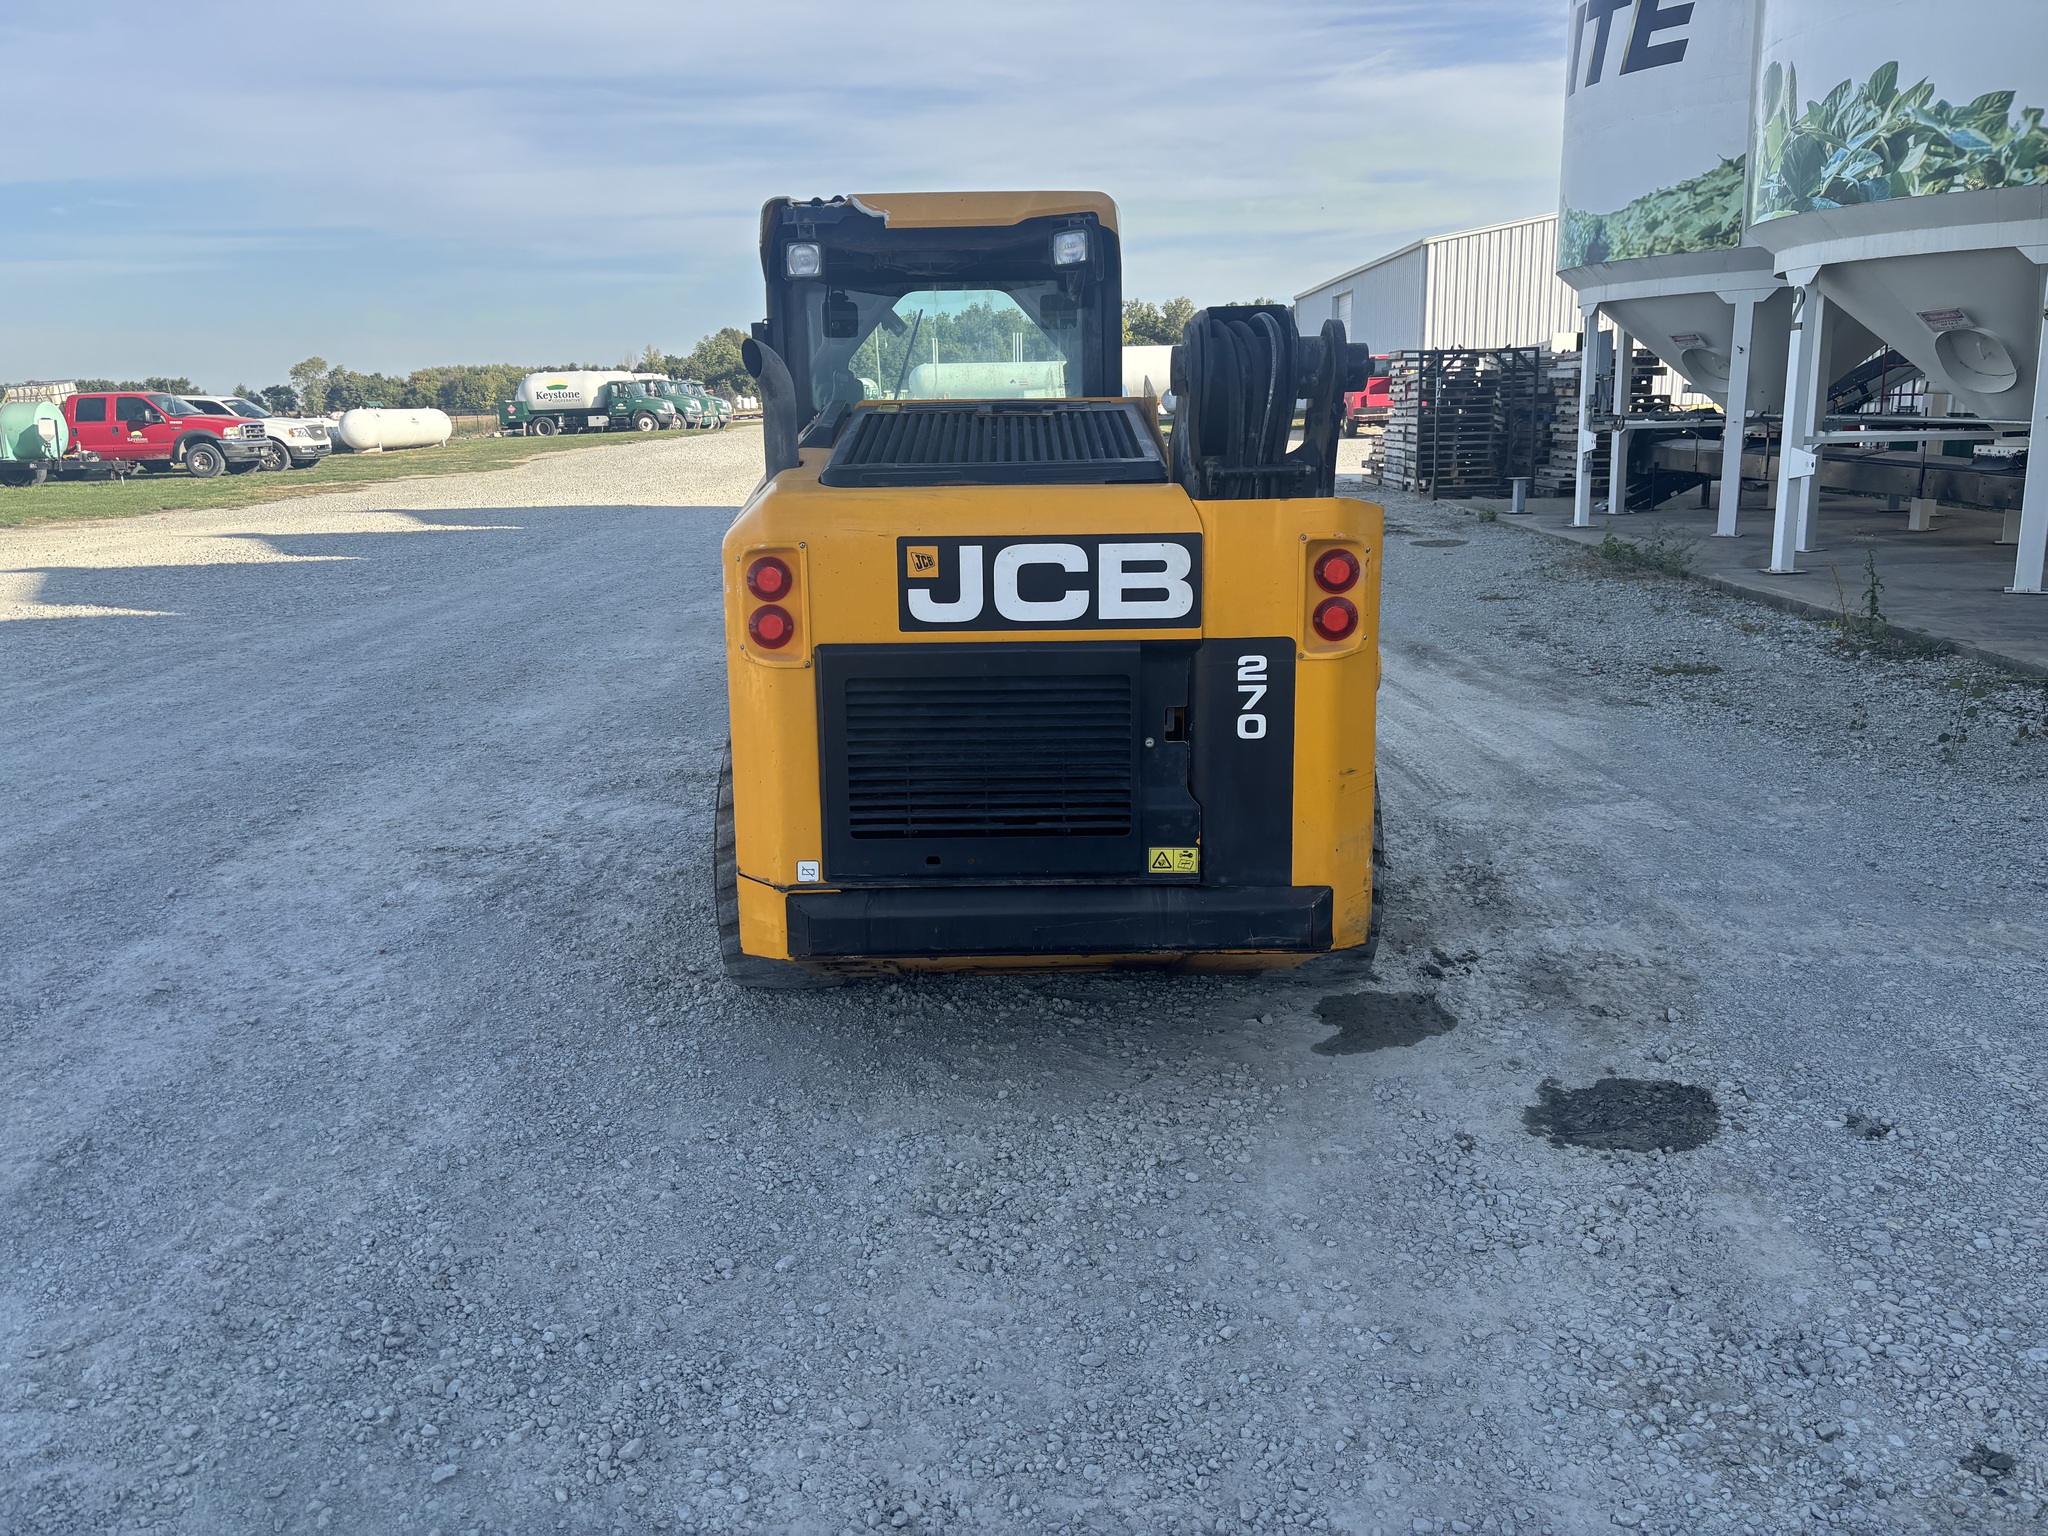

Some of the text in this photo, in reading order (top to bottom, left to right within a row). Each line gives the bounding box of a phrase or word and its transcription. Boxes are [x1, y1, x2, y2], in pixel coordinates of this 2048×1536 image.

[536, 391, 580, 402] Keystone
[908, 543, 1194, 623] JCB
[914, 553, 935, 570] JCB
[1237, 655, 1268, 739] 270
